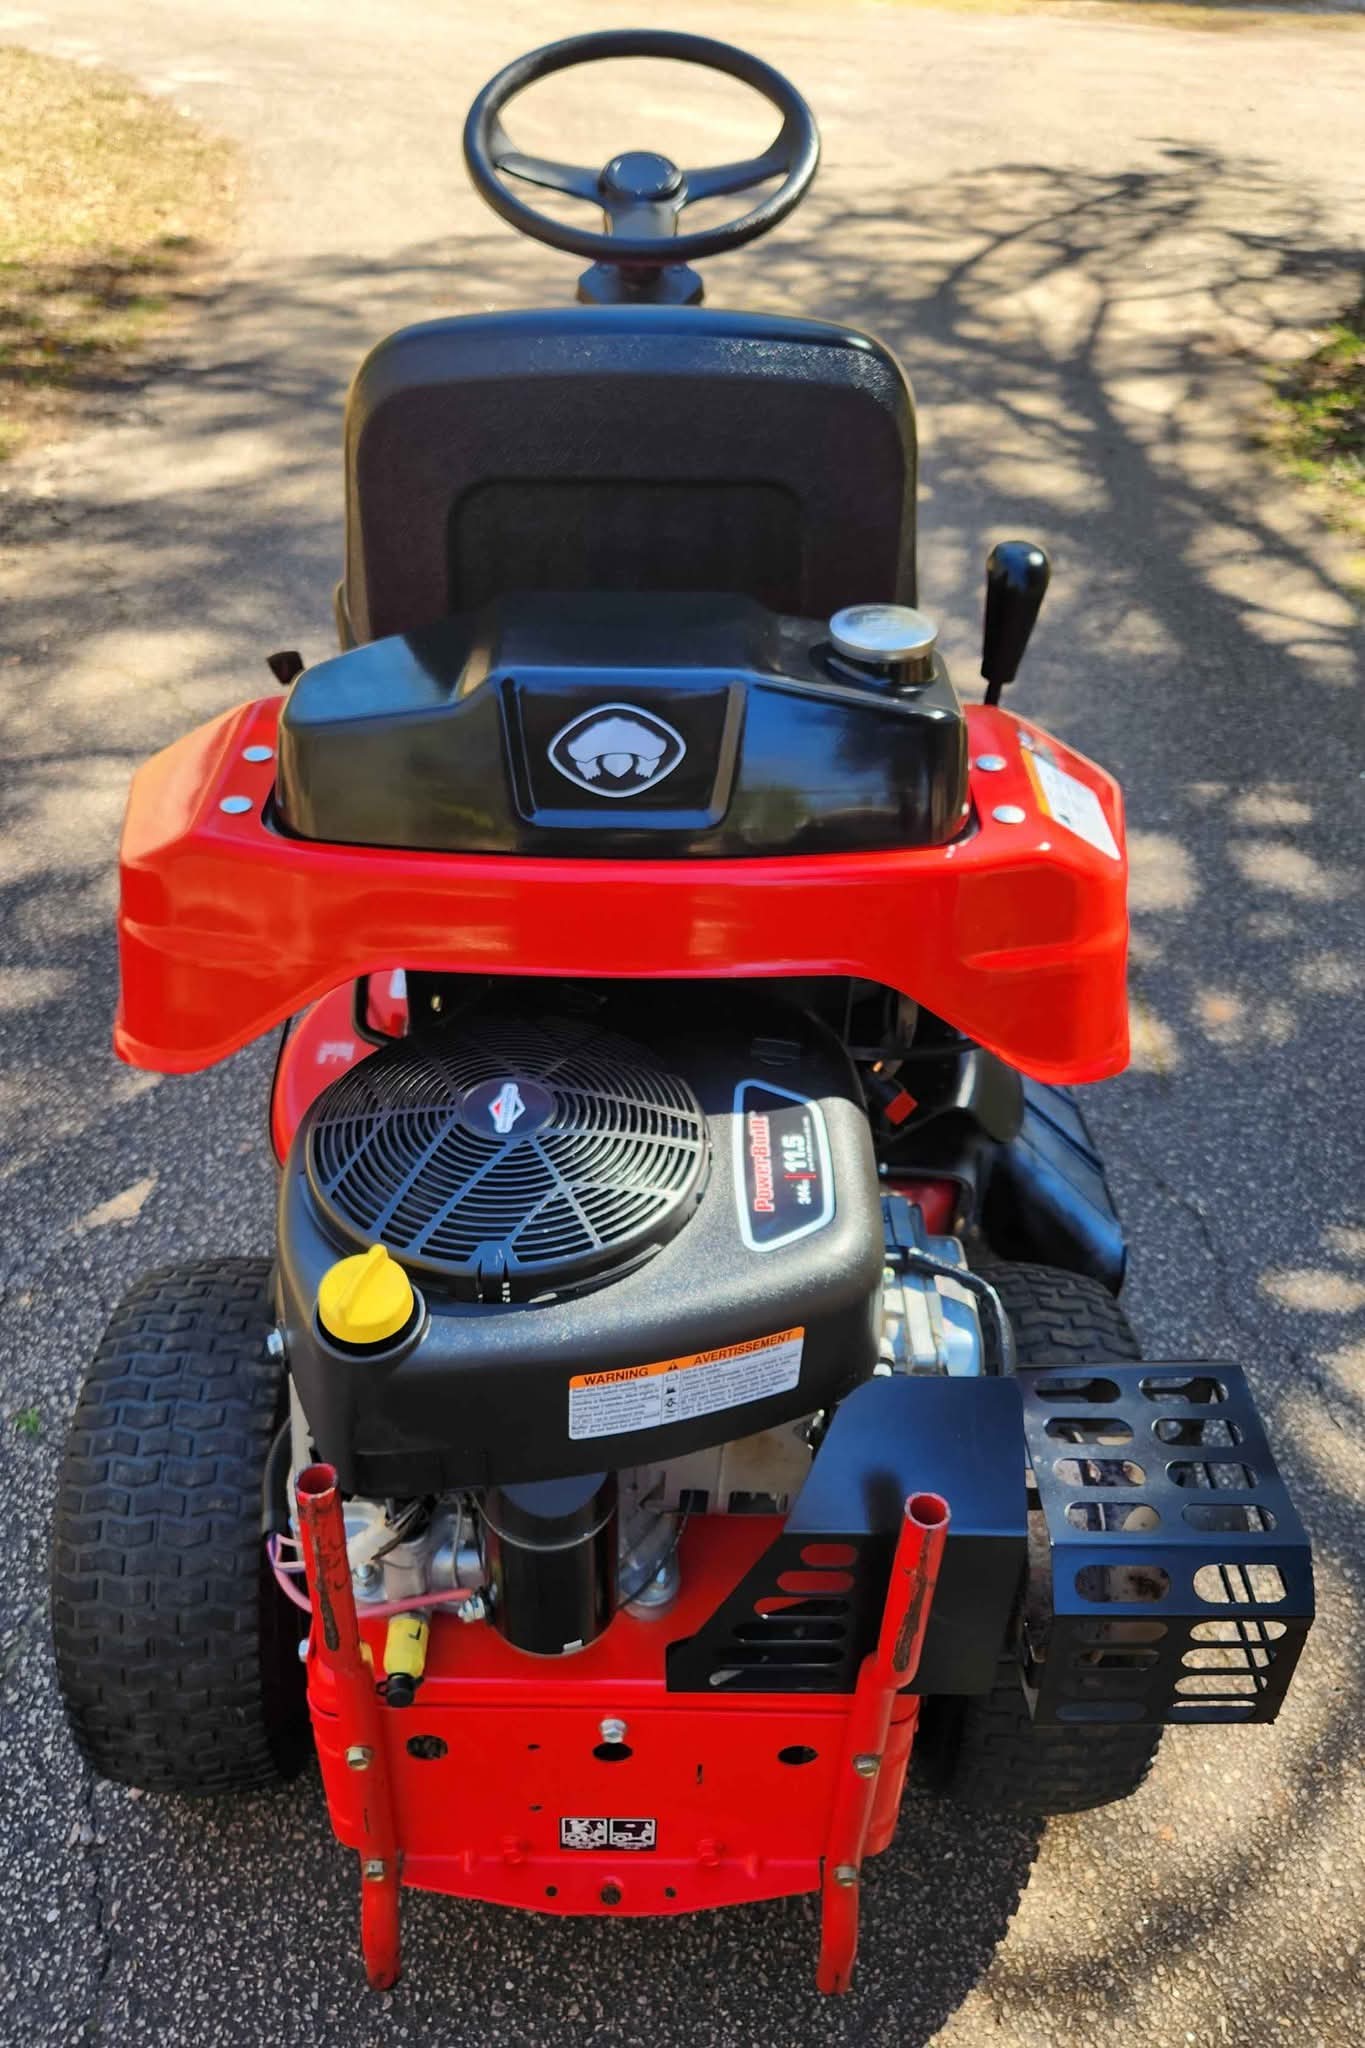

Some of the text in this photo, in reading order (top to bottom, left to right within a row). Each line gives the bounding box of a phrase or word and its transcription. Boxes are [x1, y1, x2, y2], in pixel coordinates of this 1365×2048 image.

[781, 1134, 807, 1173] 11.5
[584, 1331, 793, 1386] WARNING AVERTISSEMENT
